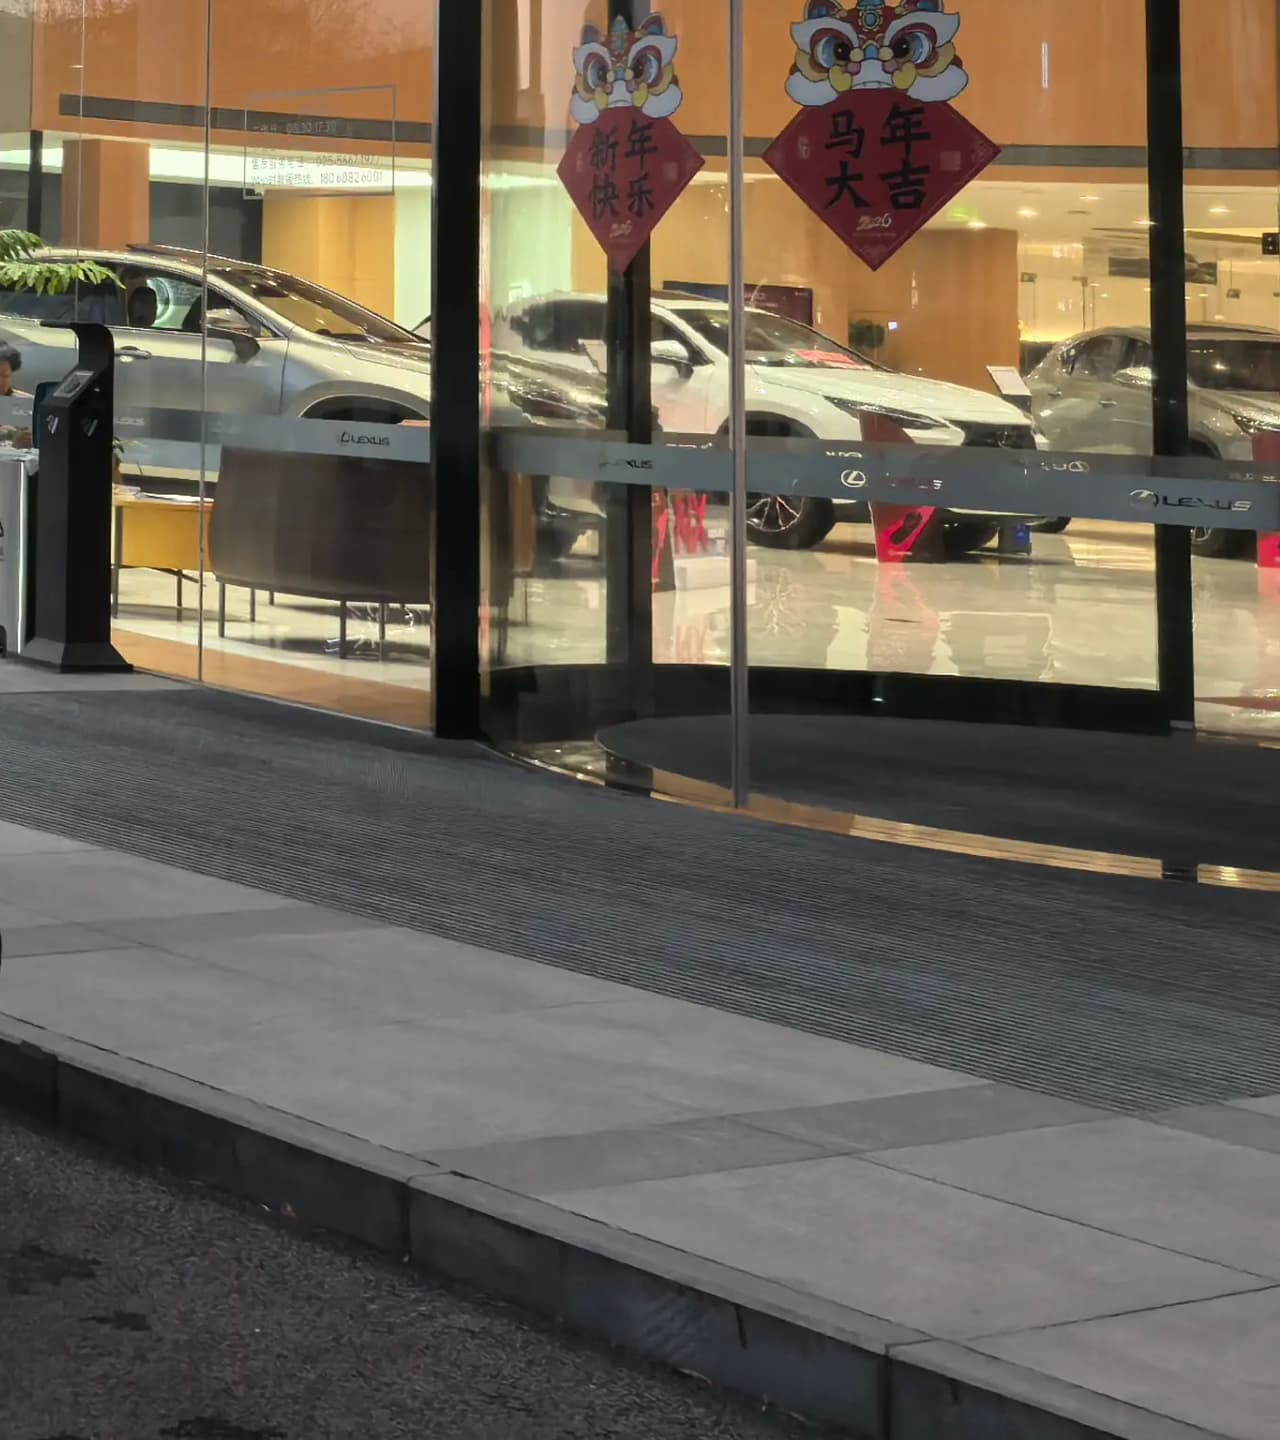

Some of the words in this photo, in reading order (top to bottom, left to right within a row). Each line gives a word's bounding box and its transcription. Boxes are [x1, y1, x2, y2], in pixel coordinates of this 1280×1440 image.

[589, 119, 658, 172] 新年
[825, 103, 933, 159] 马年
[589, 172, 656, 220] 快乐
[824, 161, 932, 210] 大吉
[351, 433, 391, 447] LEXUS
